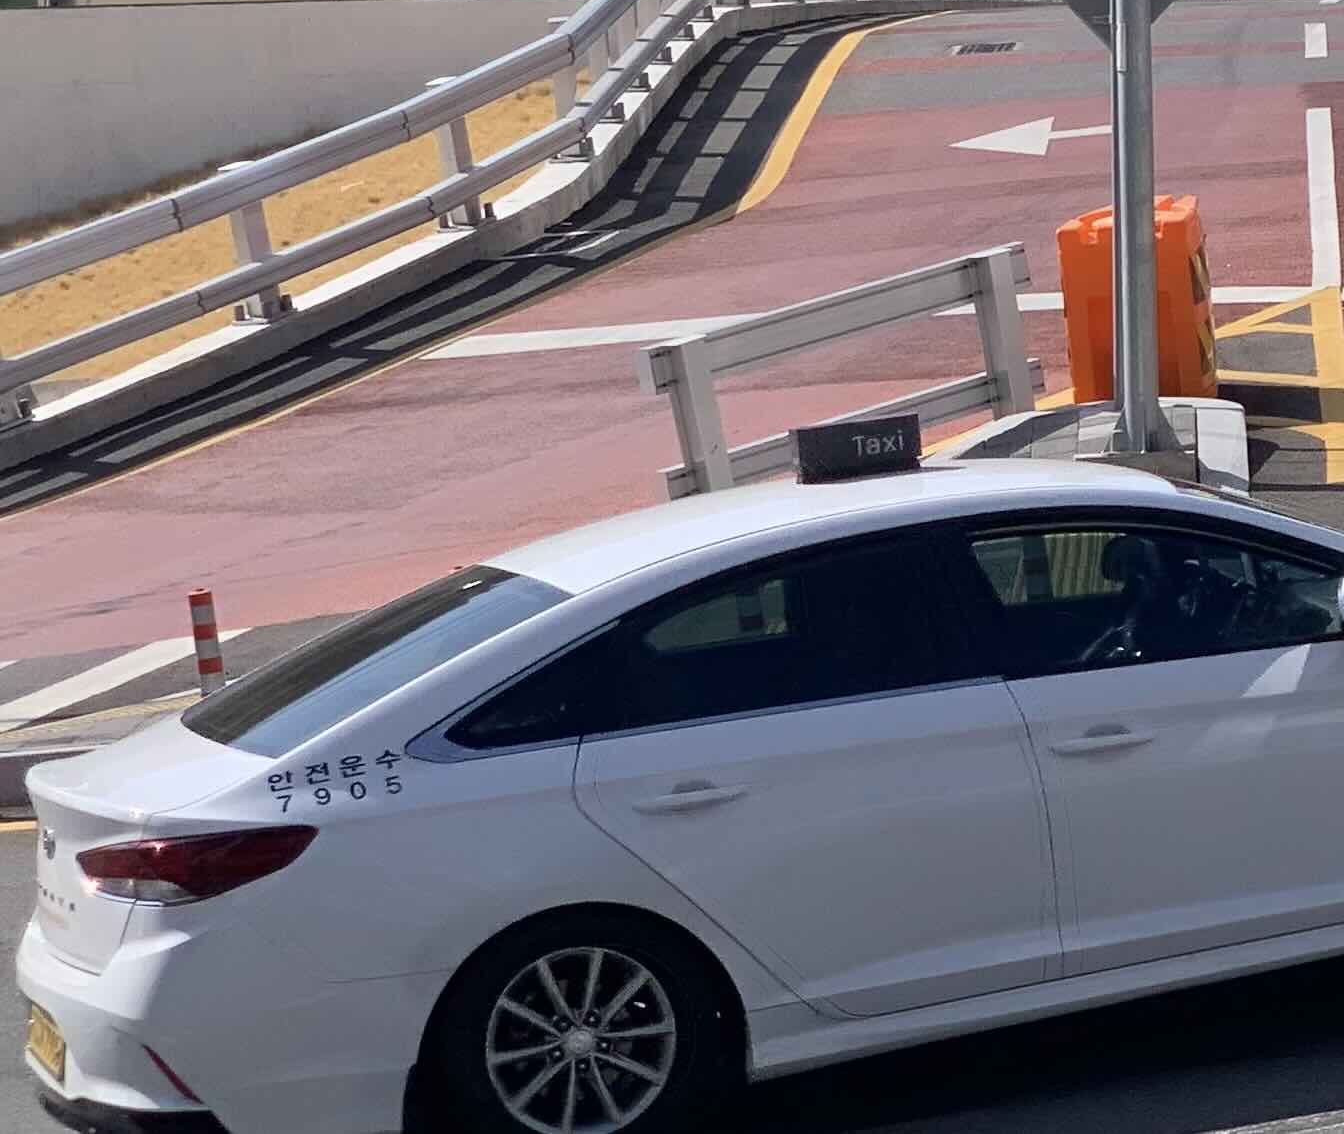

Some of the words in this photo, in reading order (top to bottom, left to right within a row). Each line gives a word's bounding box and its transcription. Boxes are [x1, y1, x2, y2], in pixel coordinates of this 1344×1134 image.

[852, 429, 904, 457] Taxi
[267, 749, 403, 793] 안전운수
[275, 775, 403, 814] 7905
